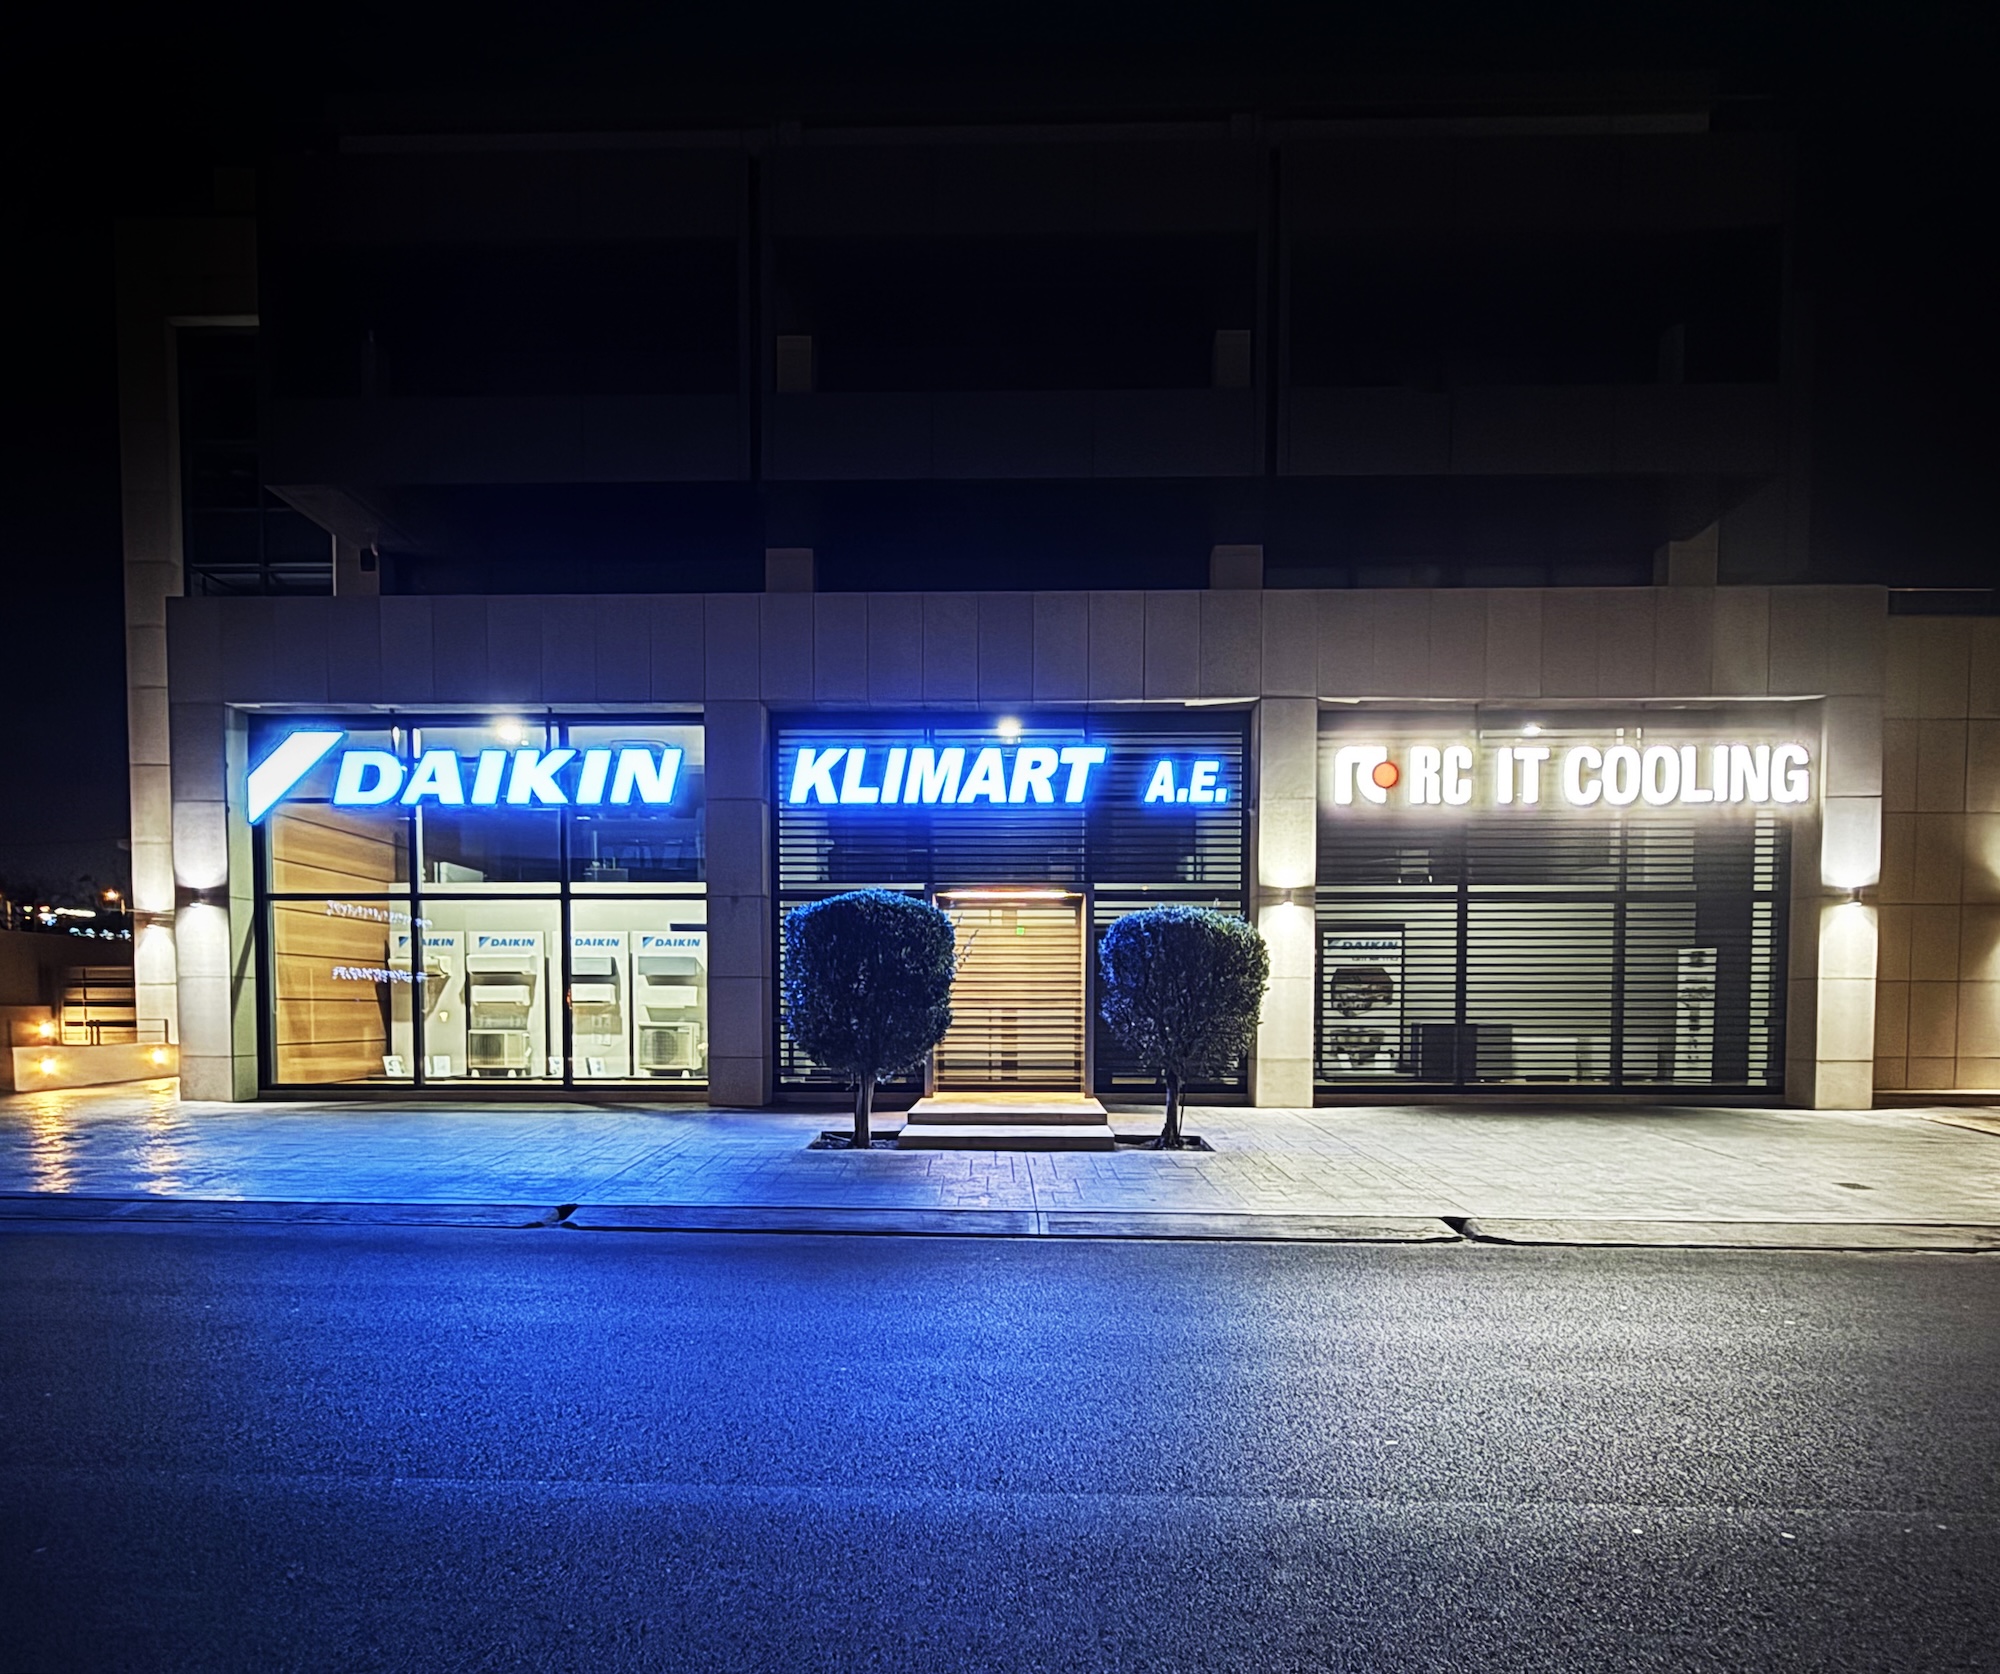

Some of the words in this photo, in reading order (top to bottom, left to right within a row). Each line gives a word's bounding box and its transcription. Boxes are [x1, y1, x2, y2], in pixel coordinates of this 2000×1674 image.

[333, 749, 682, 805] DAIKIN
[789, 747, 1106, 803] KLIMART
[1144, 760, 1228, 803] A.E.
[1409, 746, 1473, 804] RC
[1497, 747, 1550, 804] IT
[1563, 745, 1809, 805] COOLING
[490, 938, 535, 947] DAIKIN
[574, 938, 620, 947] DAIKIN
[655, 938, 701, 947] DAIKIN
